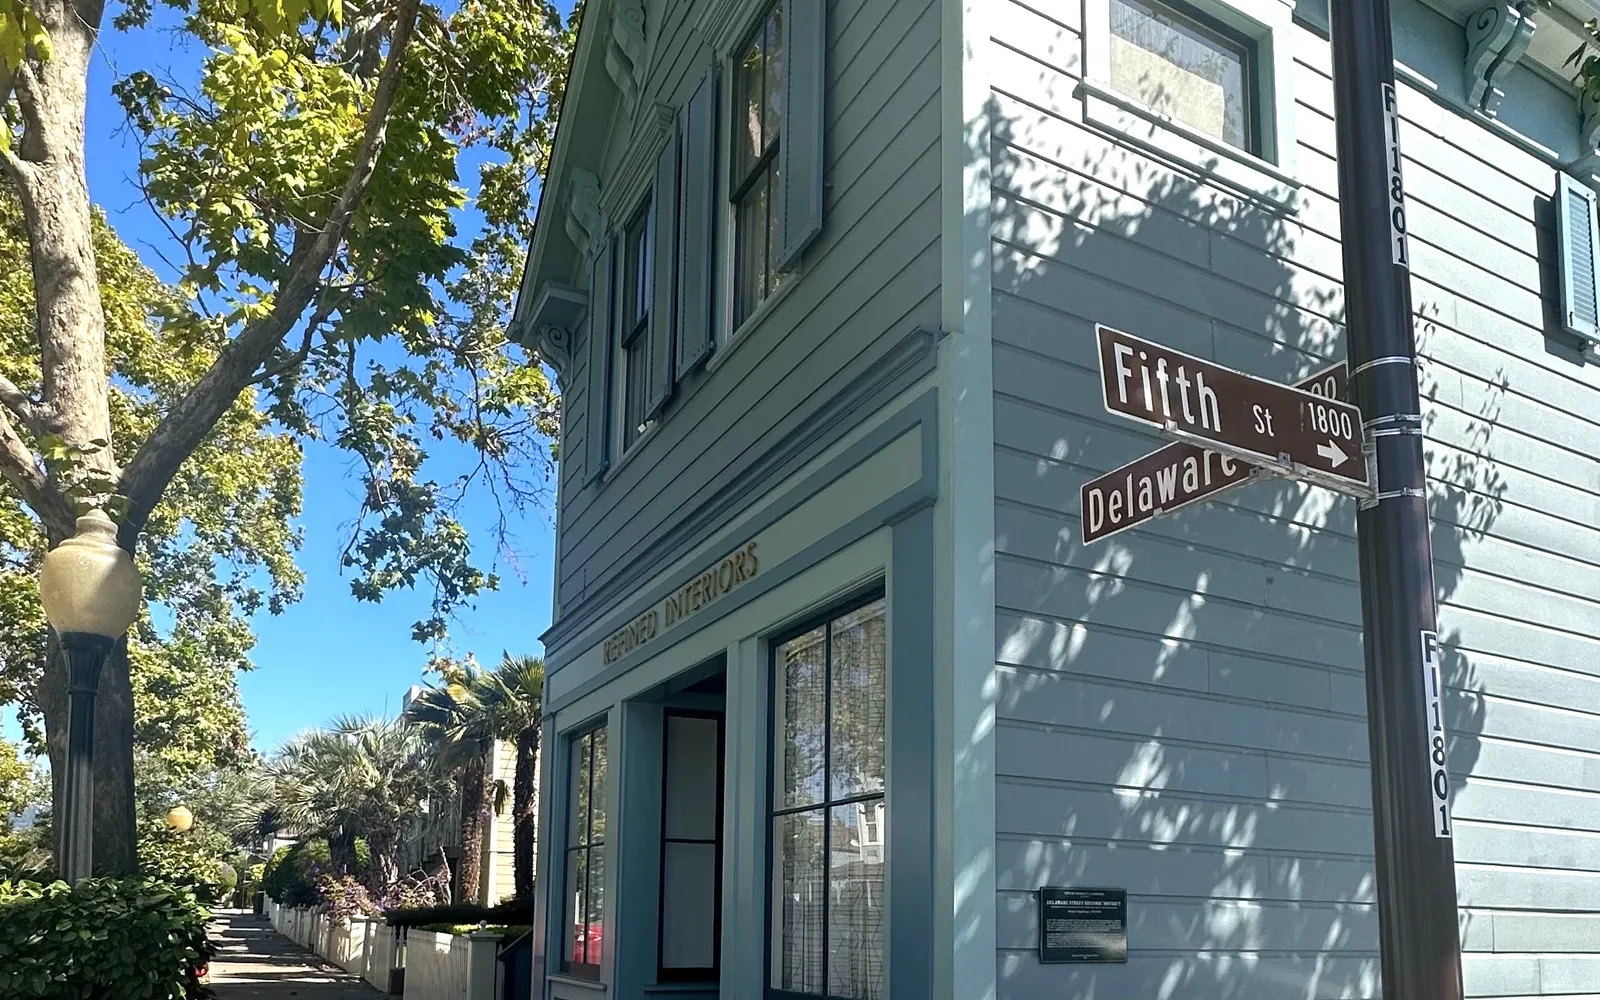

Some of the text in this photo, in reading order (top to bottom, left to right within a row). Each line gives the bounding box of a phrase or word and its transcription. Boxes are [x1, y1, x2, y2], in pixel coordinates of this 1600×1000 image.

[1113, 342, 1352, 440] Fifth St 1800
[1088, 449, 1237, 533] Delaware
[603, 541, 758, 666] REFINED INTERIORS
